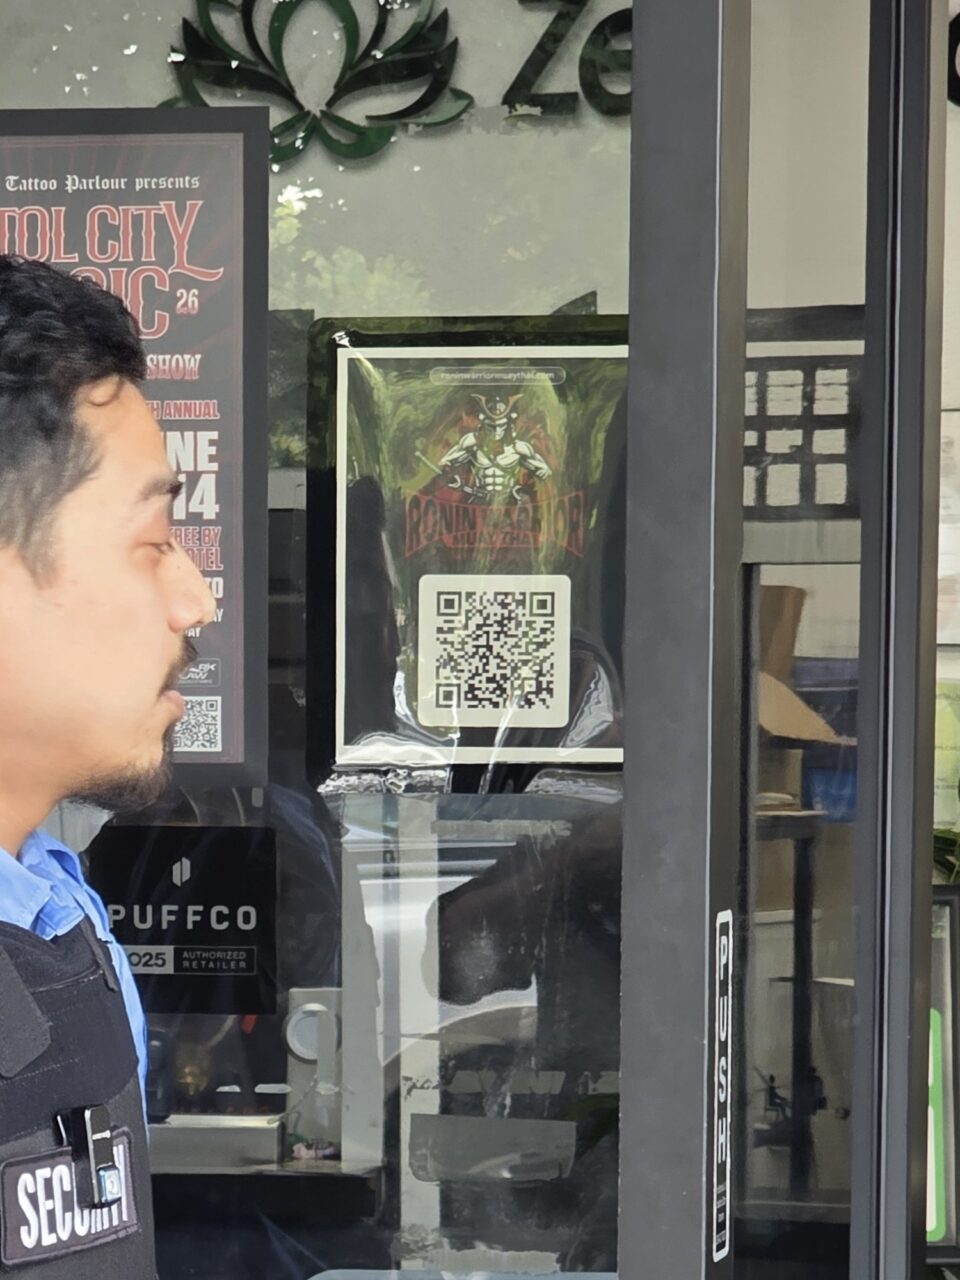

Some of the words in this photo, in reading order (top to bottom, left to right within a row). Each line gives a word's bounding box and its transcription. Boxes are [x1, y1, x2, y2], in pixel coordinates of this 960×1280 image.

[5, 176, 57, 191] Tattoo
[65, 174, 127, 193] Parlour
[135, 174, 200, 192] presents
[85, 201, 224, 281] CITY
[176, 288, 199, 314] 26
[146, 354, 201, 380] SHOW
[162, 400, 220, 419] ANNUAL
[201, 526, 222, 546] BY
[107, 905, 257, 931] PUFFCO
[129, 952, 166, 968] 025
[182, 951, 247, 960] AUTHORIZED
[182, 961, 247, 969] RETAILER
[718, 935, 728, 1164] PUSH
